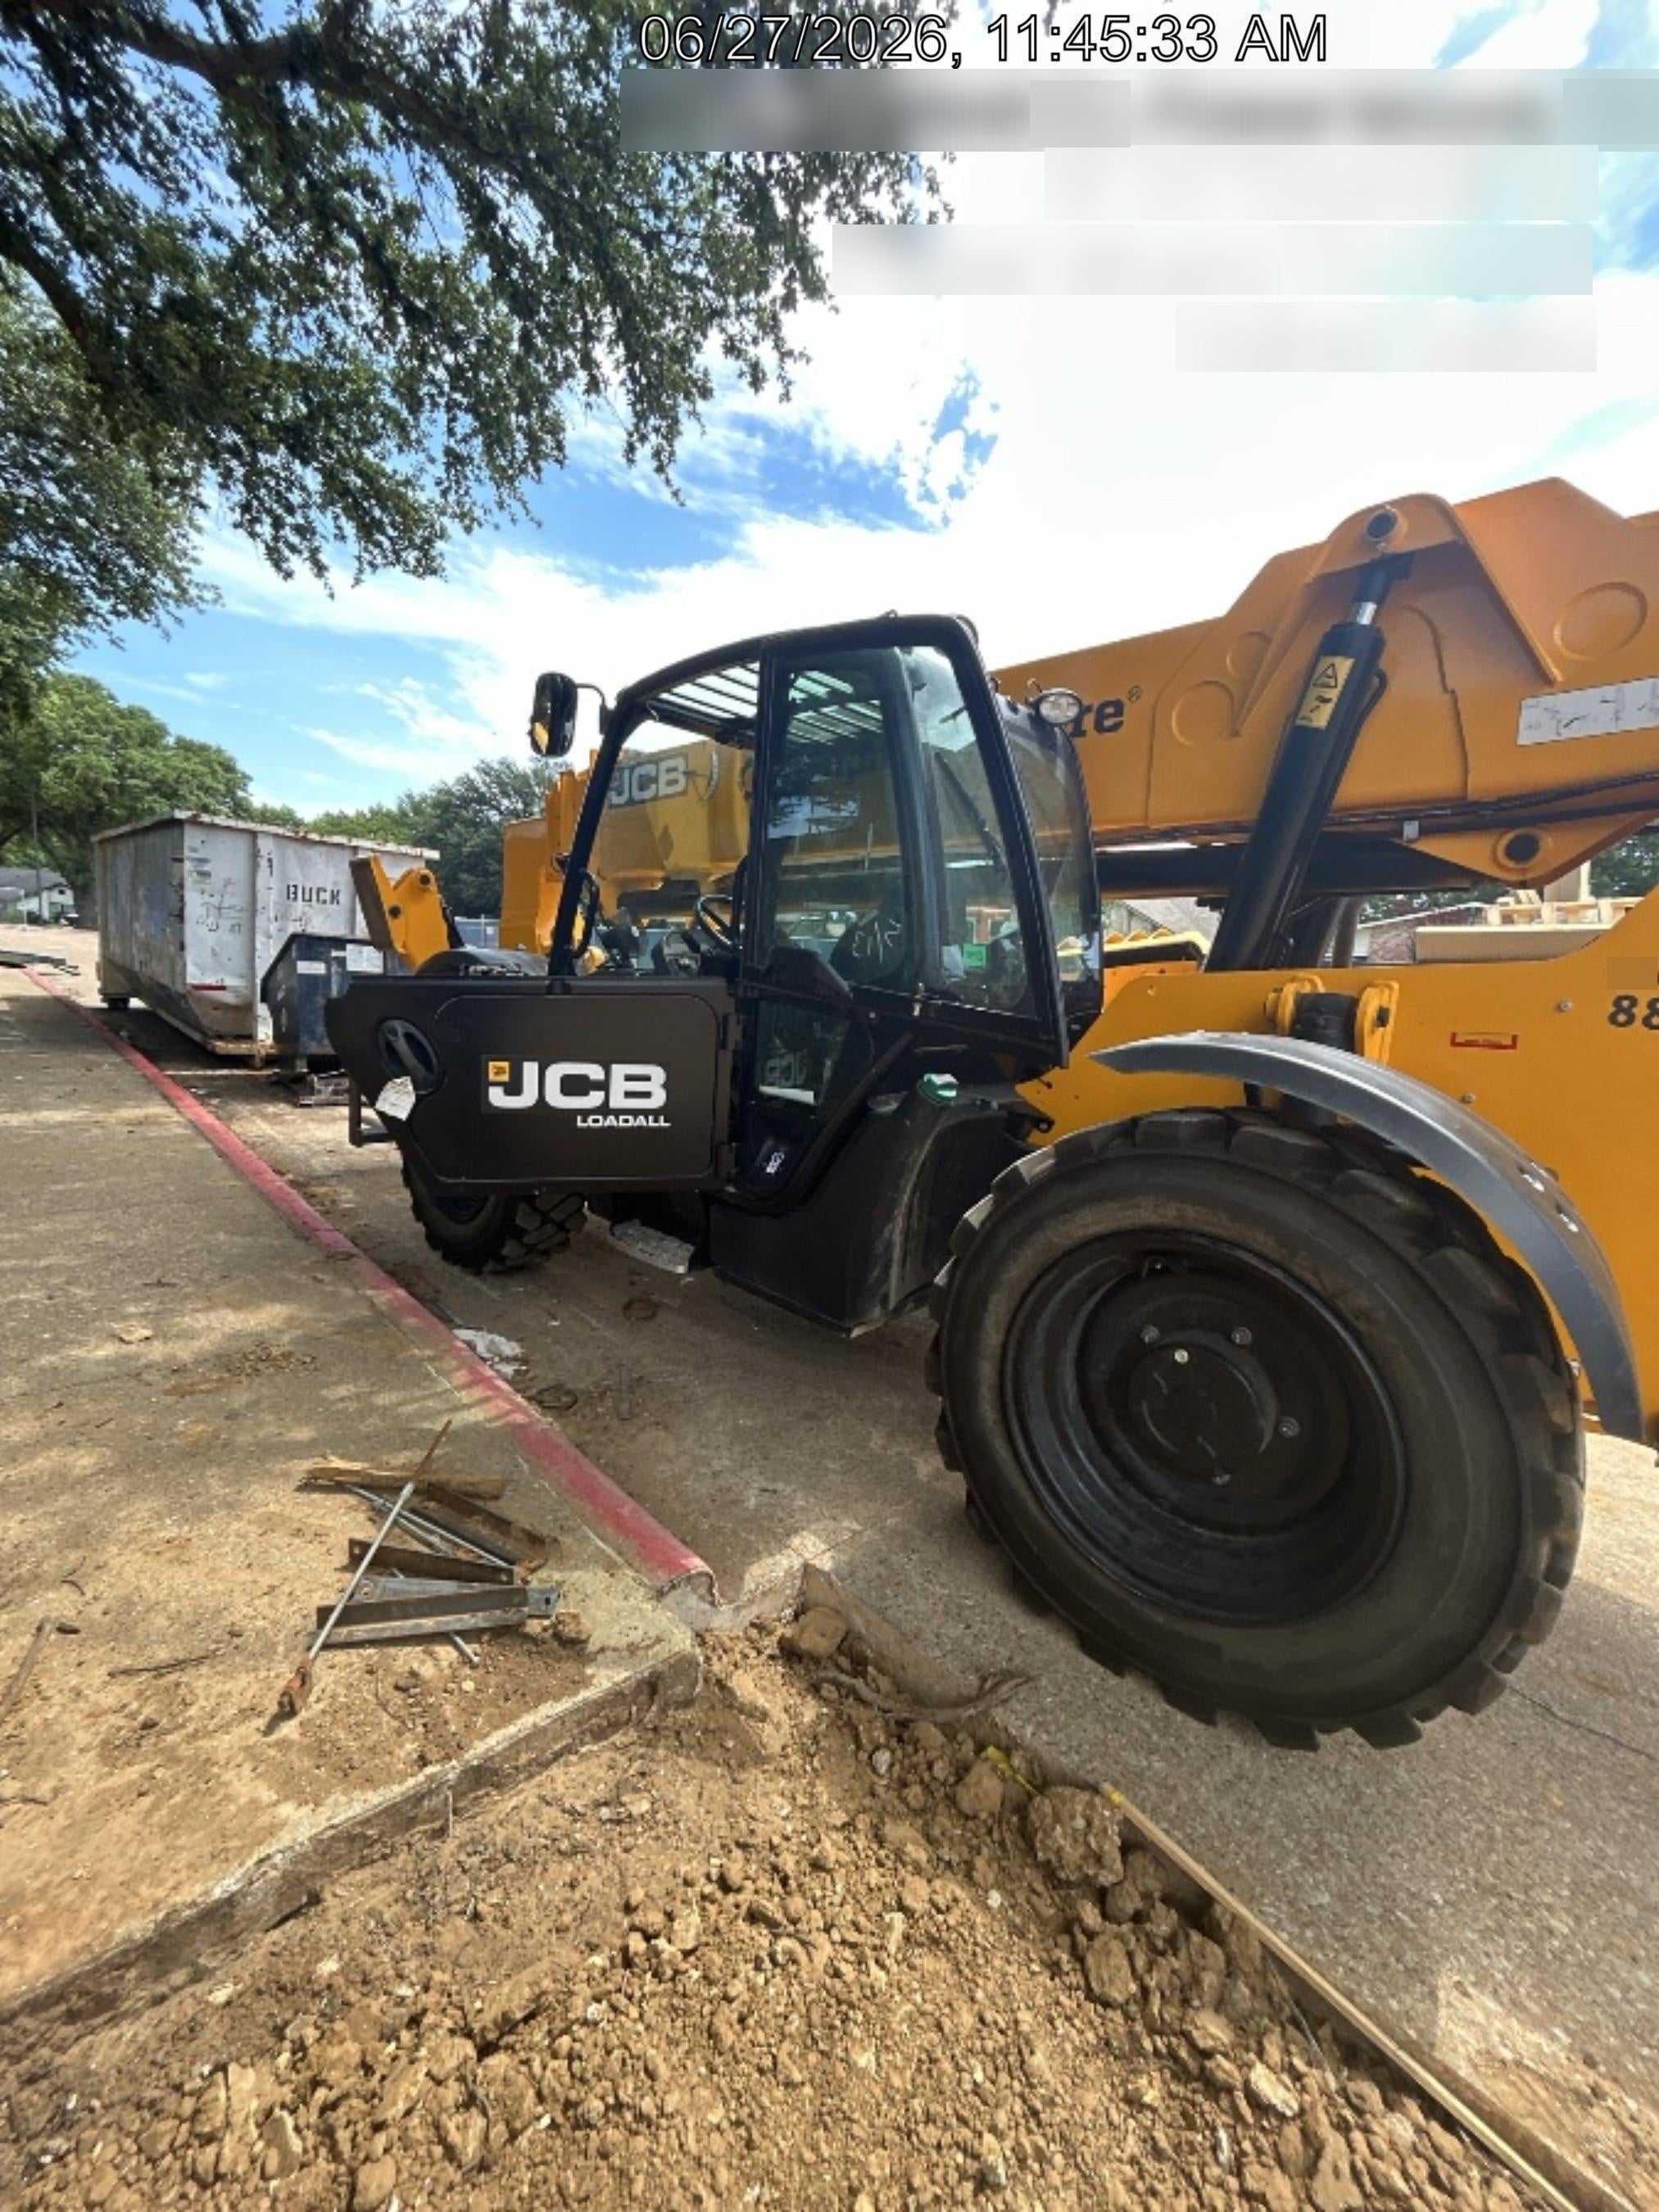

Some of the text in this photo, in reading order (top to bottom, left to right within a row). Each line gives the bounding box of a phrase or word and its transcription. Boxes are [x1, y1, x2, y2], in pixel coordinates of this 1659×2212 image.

[610, 757, 687, 805] JCB
[488, 1061, 667, 1108] JCB
[577, 1115, 671, 1127] LOADALL
